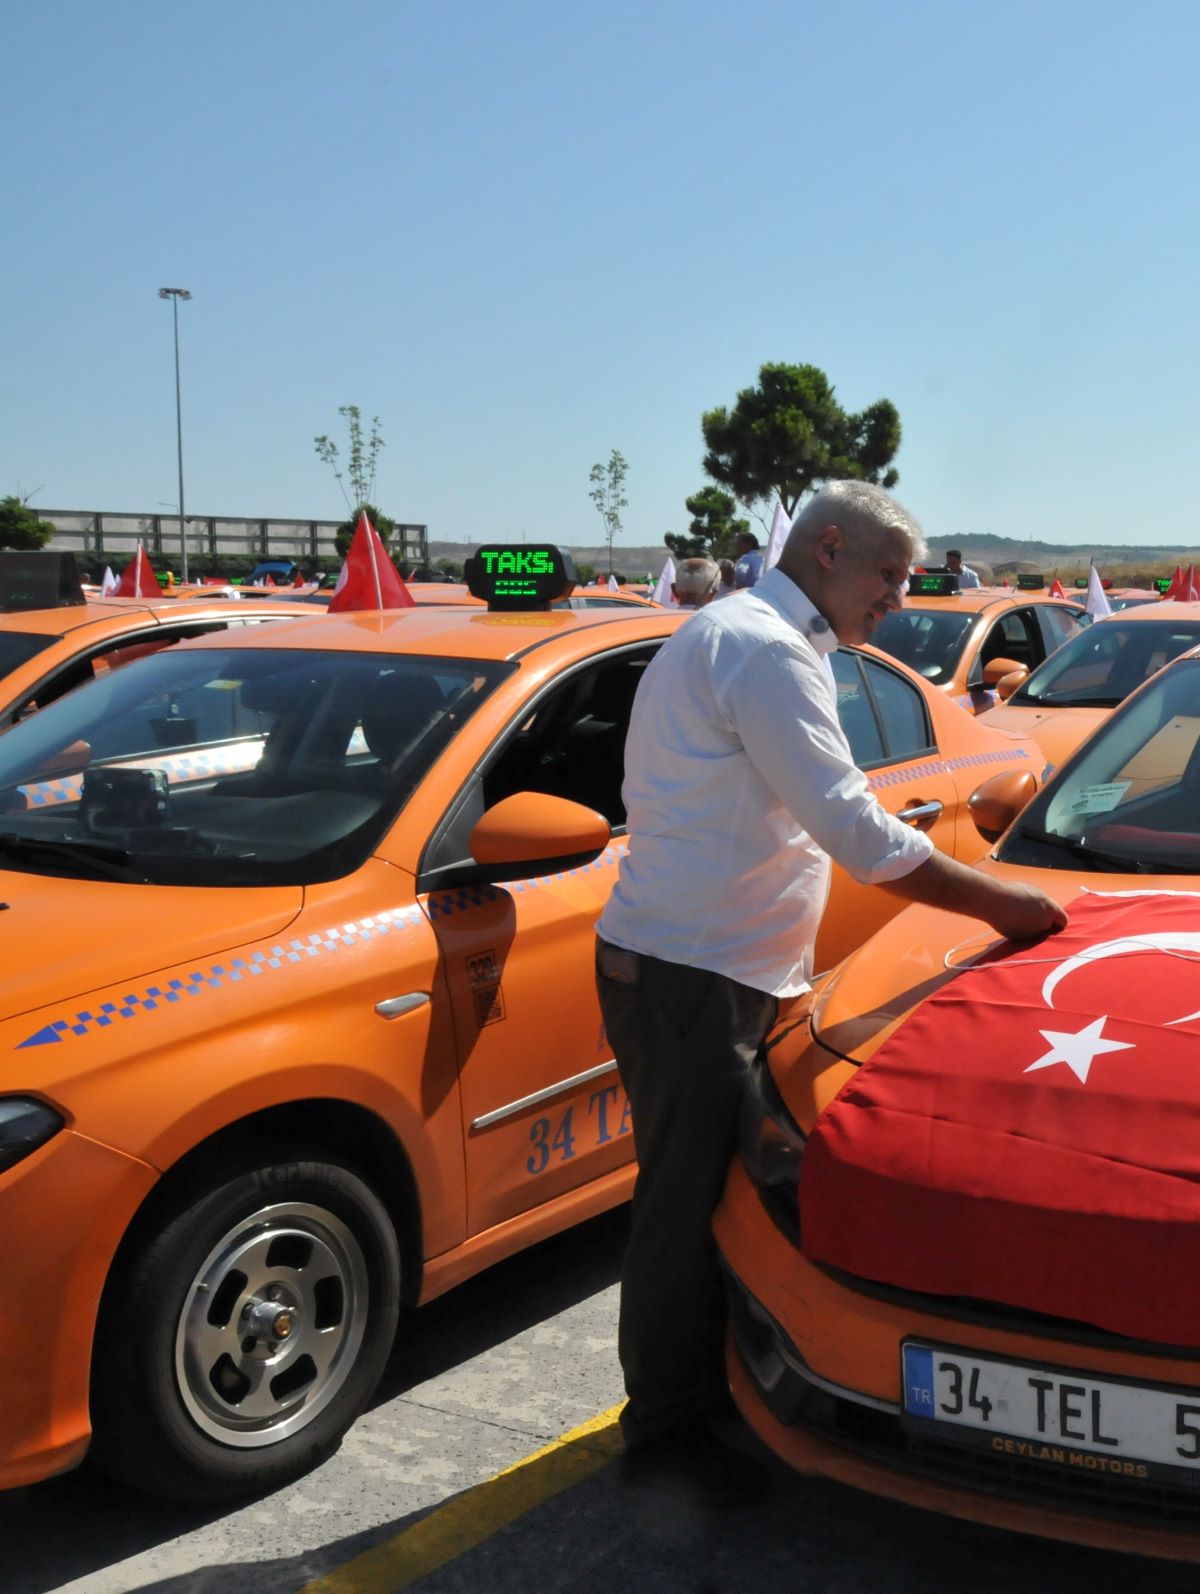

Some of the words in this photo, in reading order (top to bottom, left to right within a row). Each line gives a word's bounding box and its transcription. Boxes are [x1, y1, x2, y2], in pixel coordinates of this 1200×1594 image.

[526, 1106, 576, 1175] 34
[911, 1387, 931, 1404] TR
[939, 1362, 993, 1421] 34
[1028, 1378, 1119, 1447] TEL
[991, 1437, 1064, 1465] CEYLAN
[1069, 1453, 1149, 1478] MOTORS
